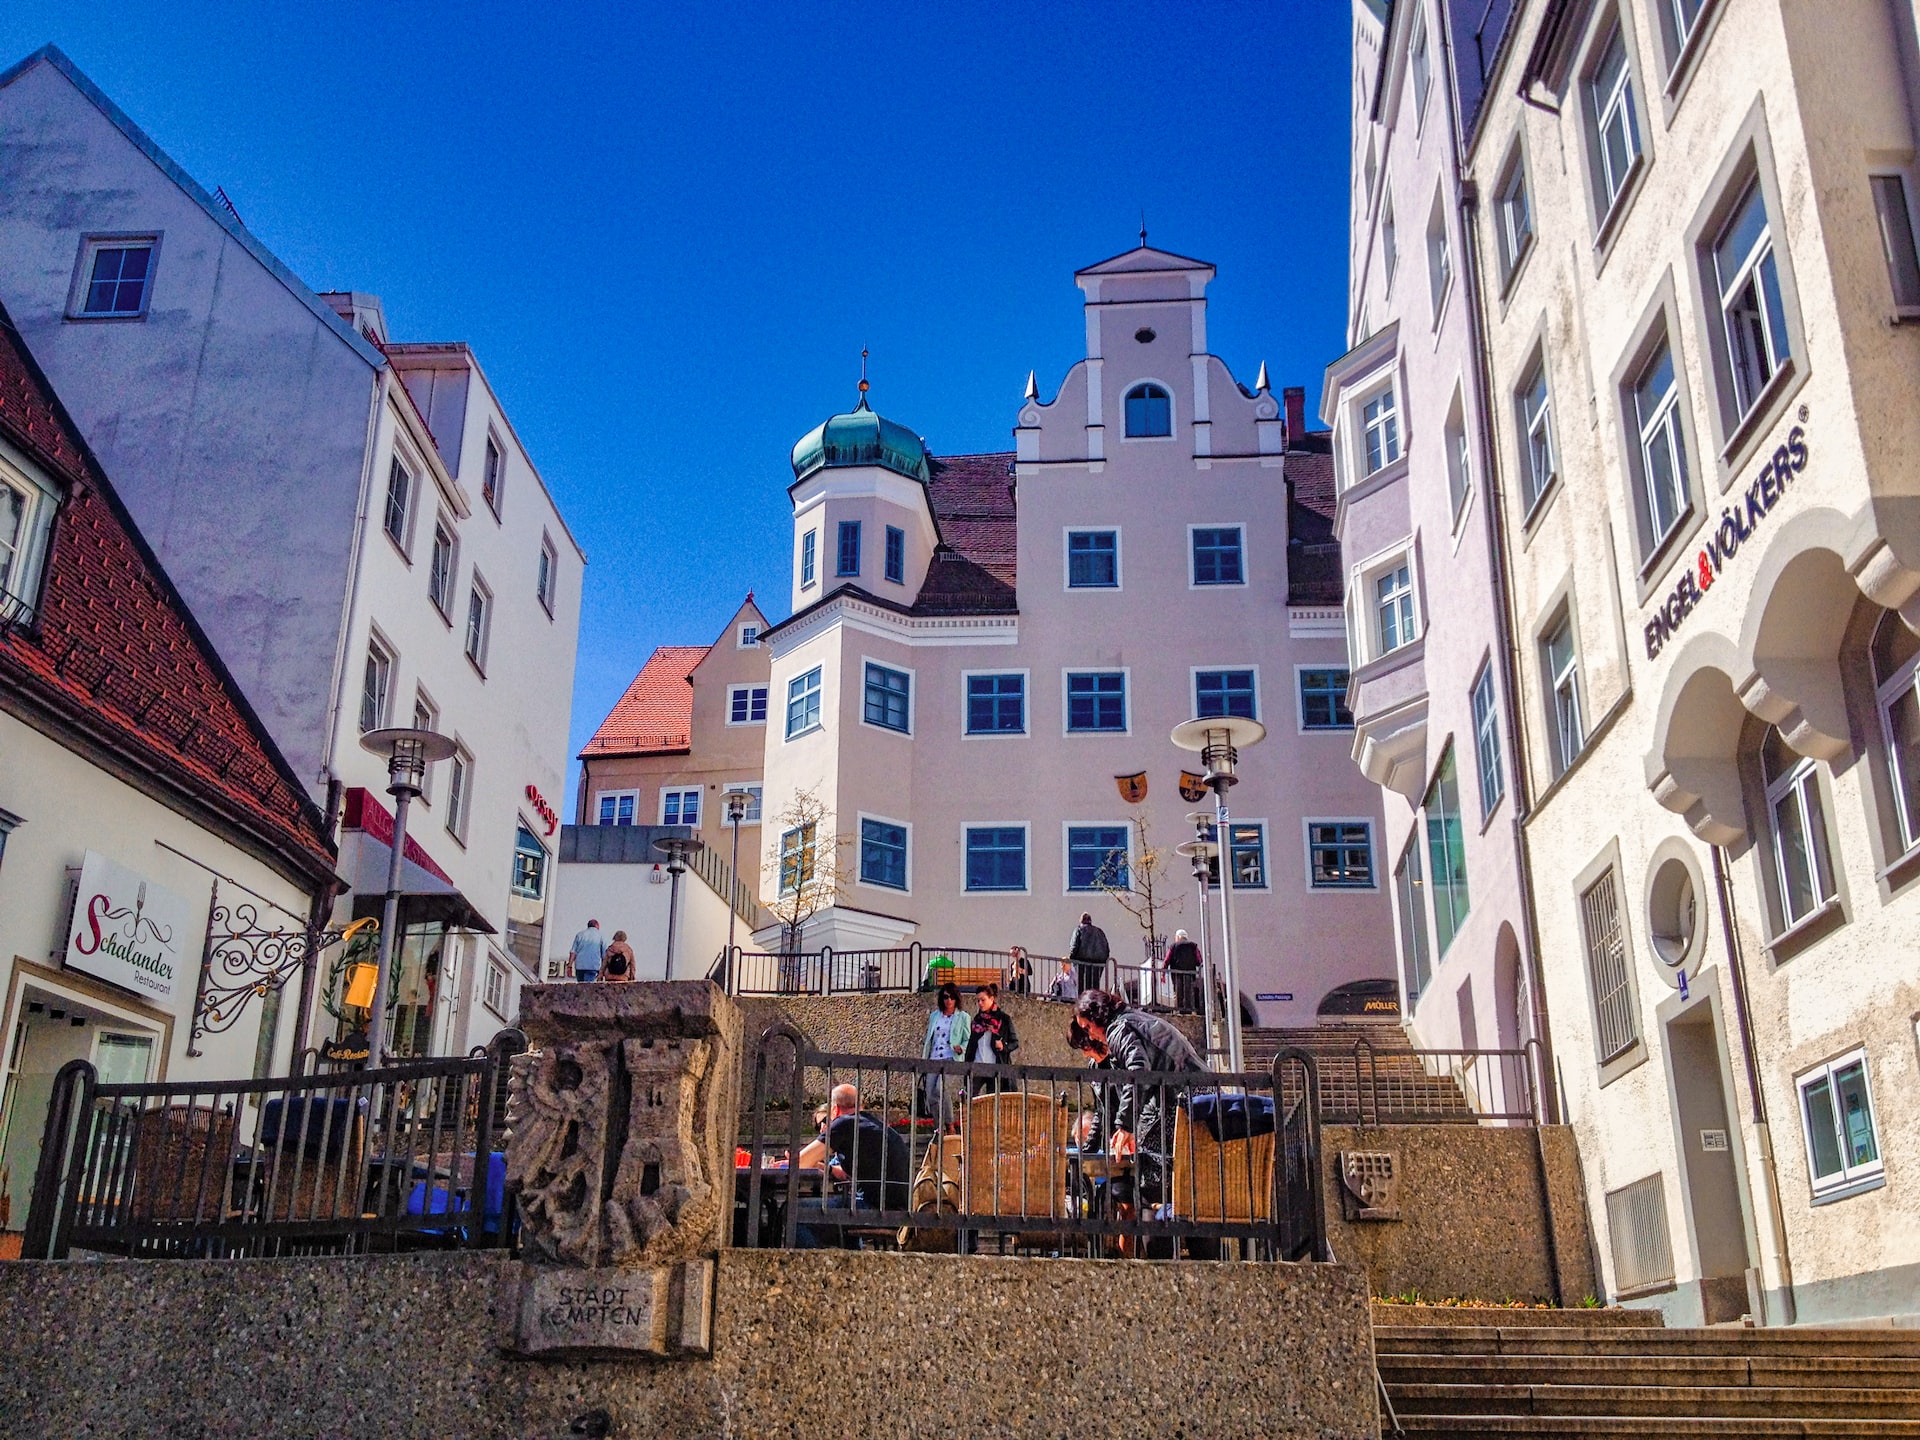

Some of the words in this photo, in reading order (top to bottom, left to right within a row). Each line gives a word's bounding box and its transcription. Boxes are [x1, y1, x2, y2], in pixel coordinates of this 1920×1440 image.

[75, 893, 174, 980] Schalander
[134, 970, 172, 995] Restaurant
[1364, 1000, 1398, 1011] MÖLLER
[559, 1286, 629, 1305] STADT
[541, 1305, 642, 1326] KEMPTEN
